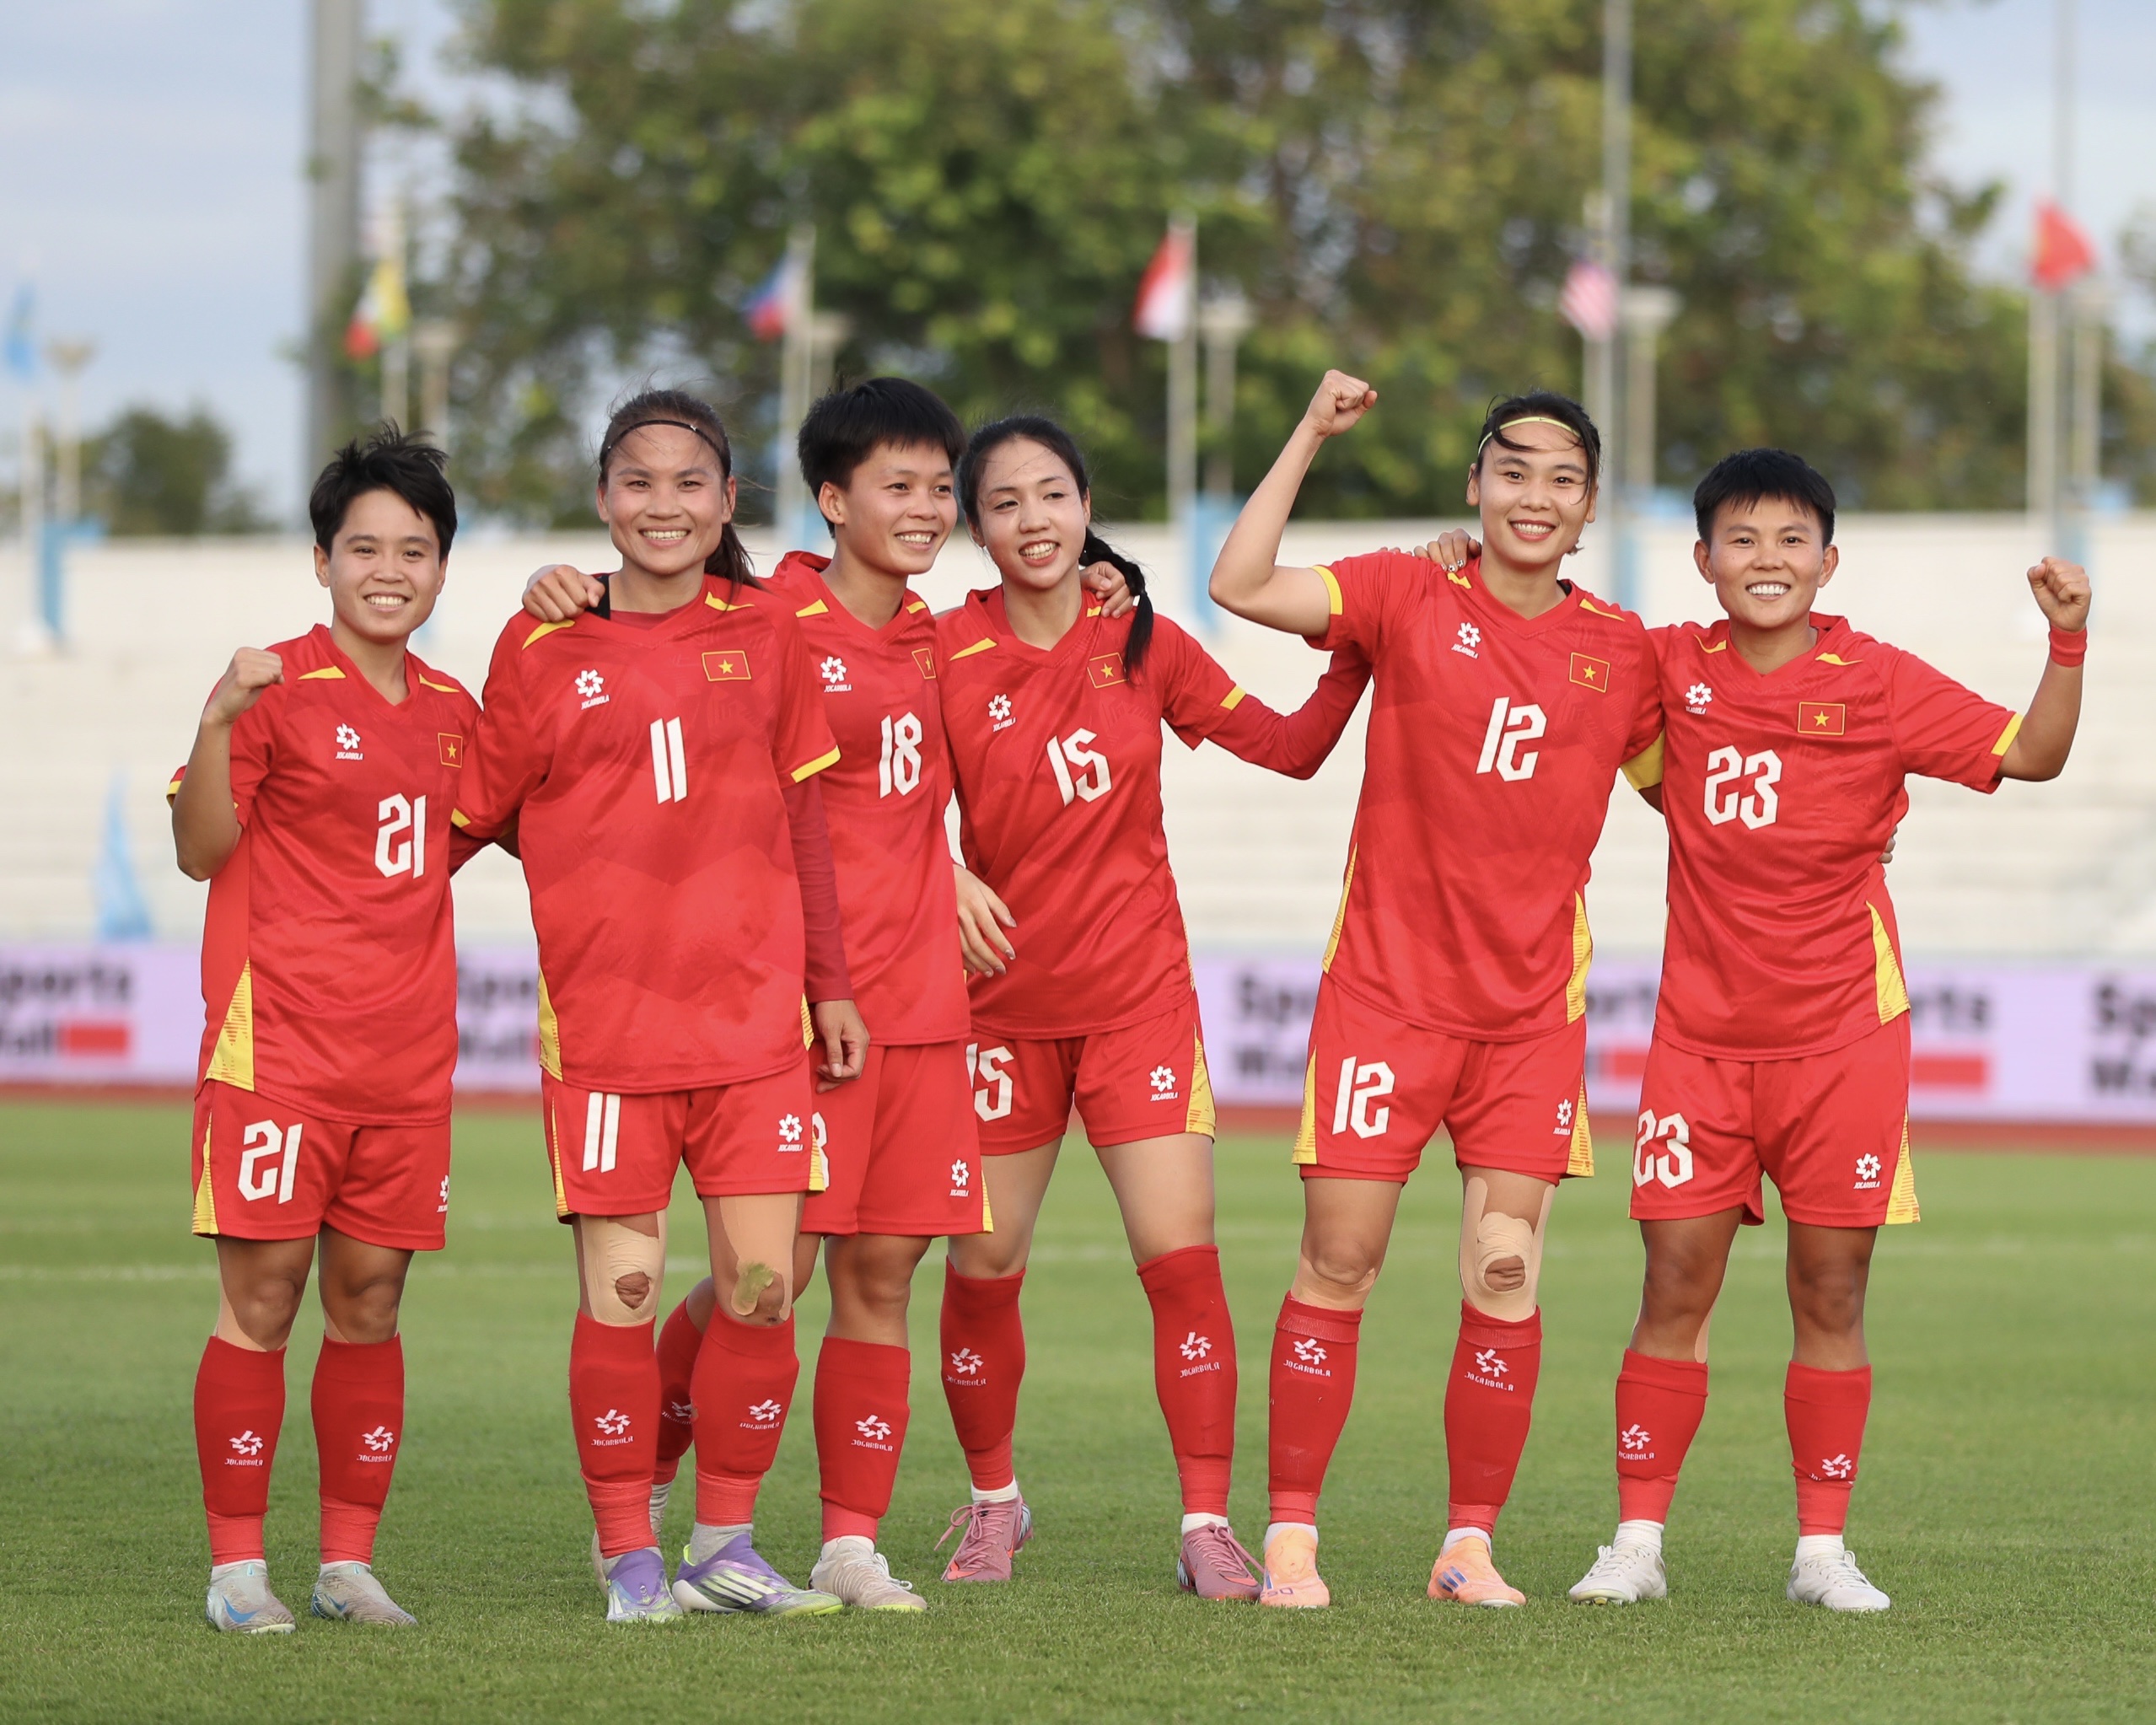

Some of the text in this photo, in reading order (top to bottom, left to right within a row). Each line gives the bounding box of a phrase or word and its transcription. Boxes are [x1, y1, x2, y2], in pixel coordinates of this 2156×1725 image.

[650, 717, 686, 803] 11
[879, 712, 922, 798] 18
[1047, 728, 1111, 805] 15
[1476, 697, 1546, 782] 12
[1704, 745, 1782, 830] 23
[375, 793, 426, 879] 21
[583, 1093, 620, 1173] 11
[1332, 1056, 1395, 1138] 12
[238, 1120, 302, 1204] 21
[1633, 1109, 1693, 1189] 23
[1618, 1450, 1654, 1460] OGARBOLA
